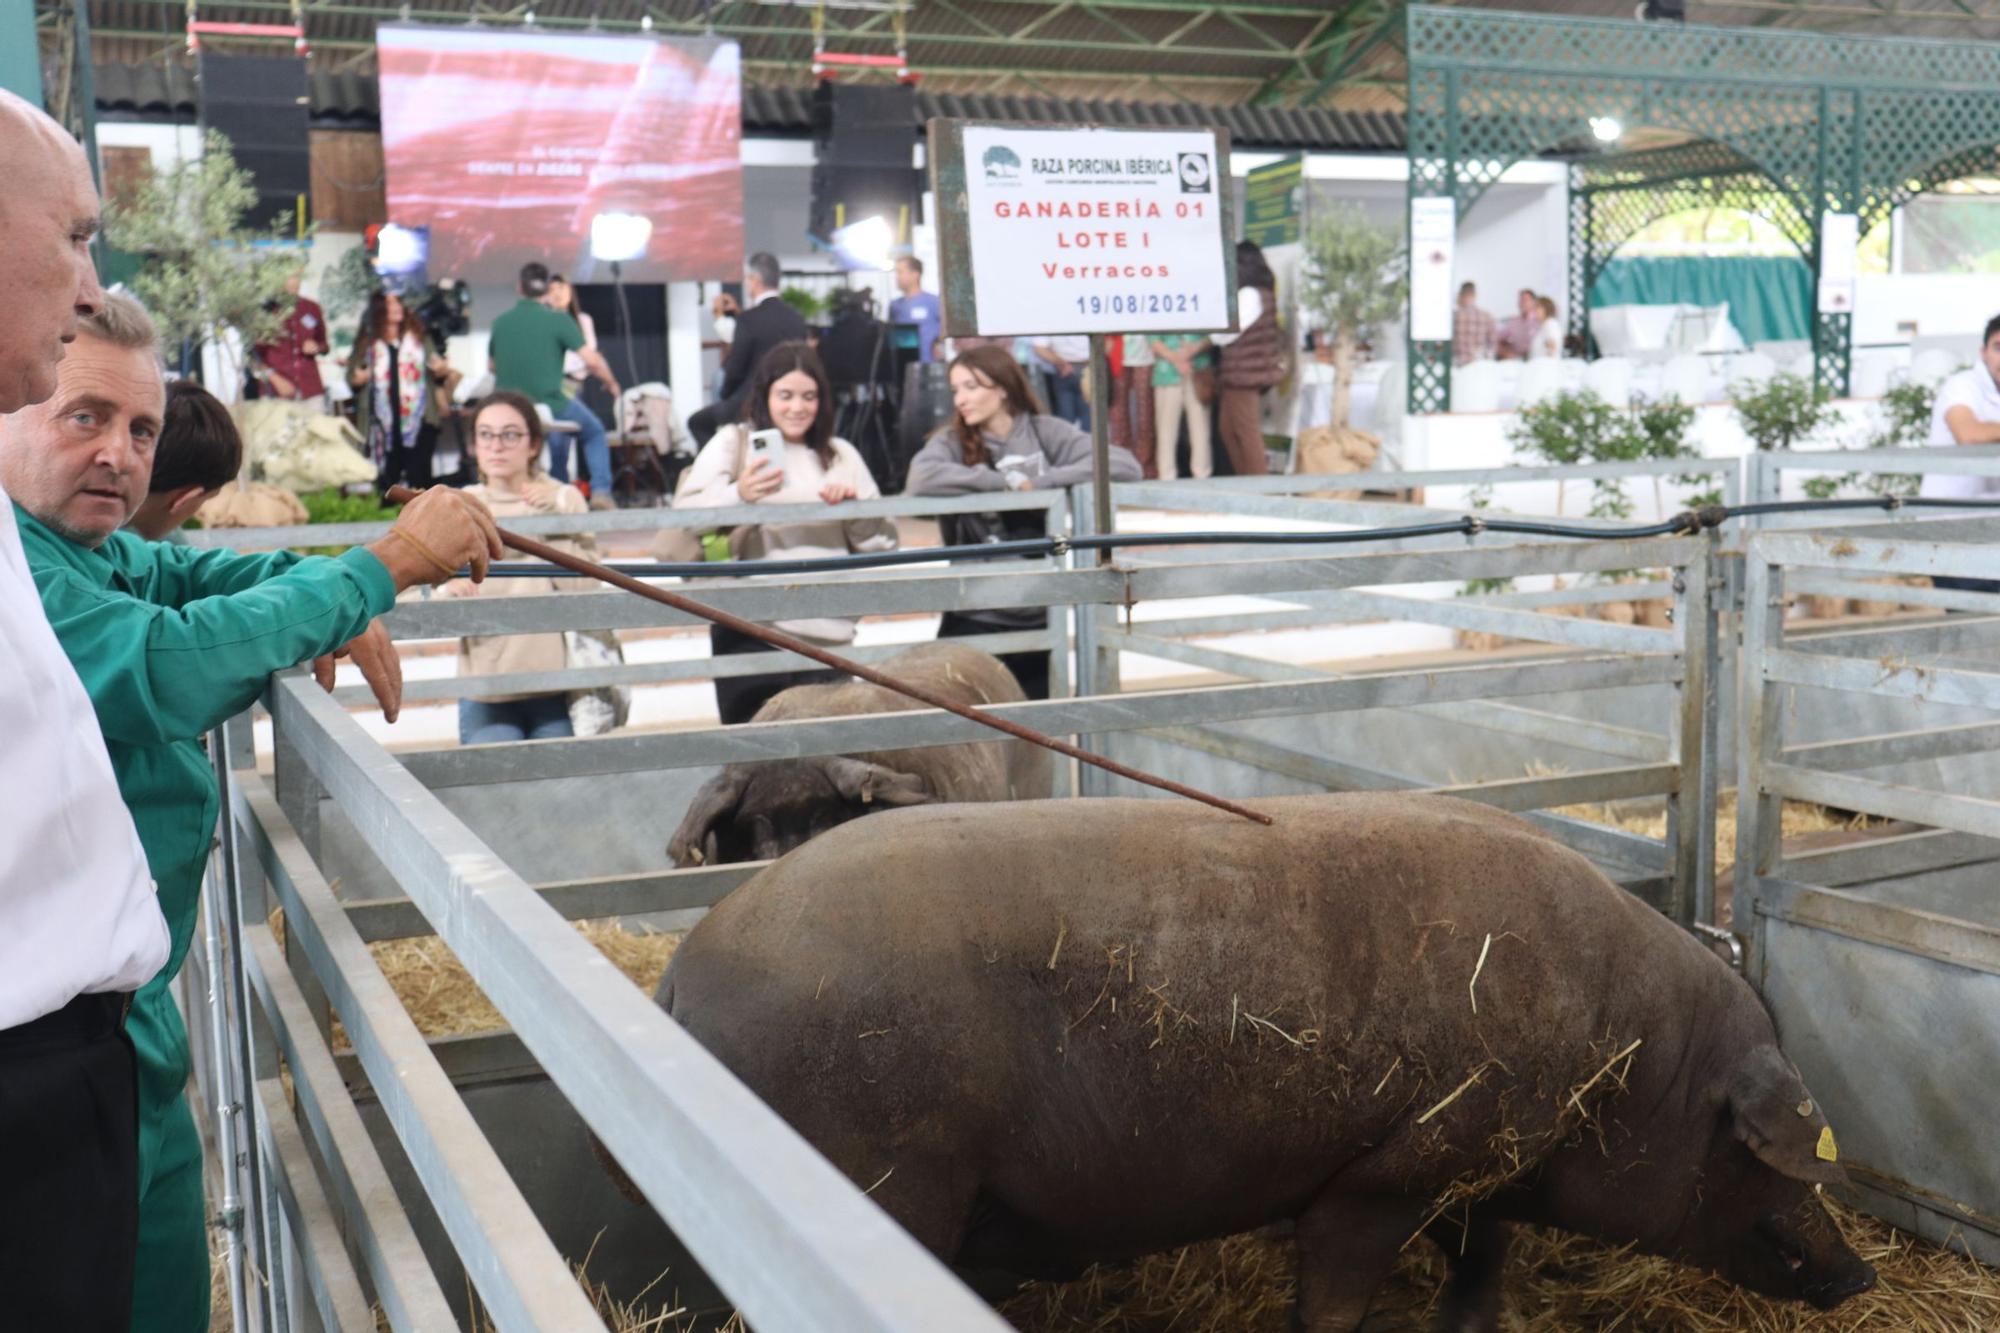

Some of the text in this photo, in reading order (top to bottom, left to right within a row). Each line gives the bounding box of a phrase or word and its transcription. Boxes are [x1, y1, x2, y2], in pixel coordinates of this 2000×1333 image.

[1031, 155, 1173, 175] RAZA PORCINA IBÉRICA
[995, 199, 1204, 217] GANADERÍA 01
[1058, 232, 1149, 247] LOTE I
[1042, 263, 1169, 279] Verracos
[1077, 294, 1200, 314] 19/08/2021
